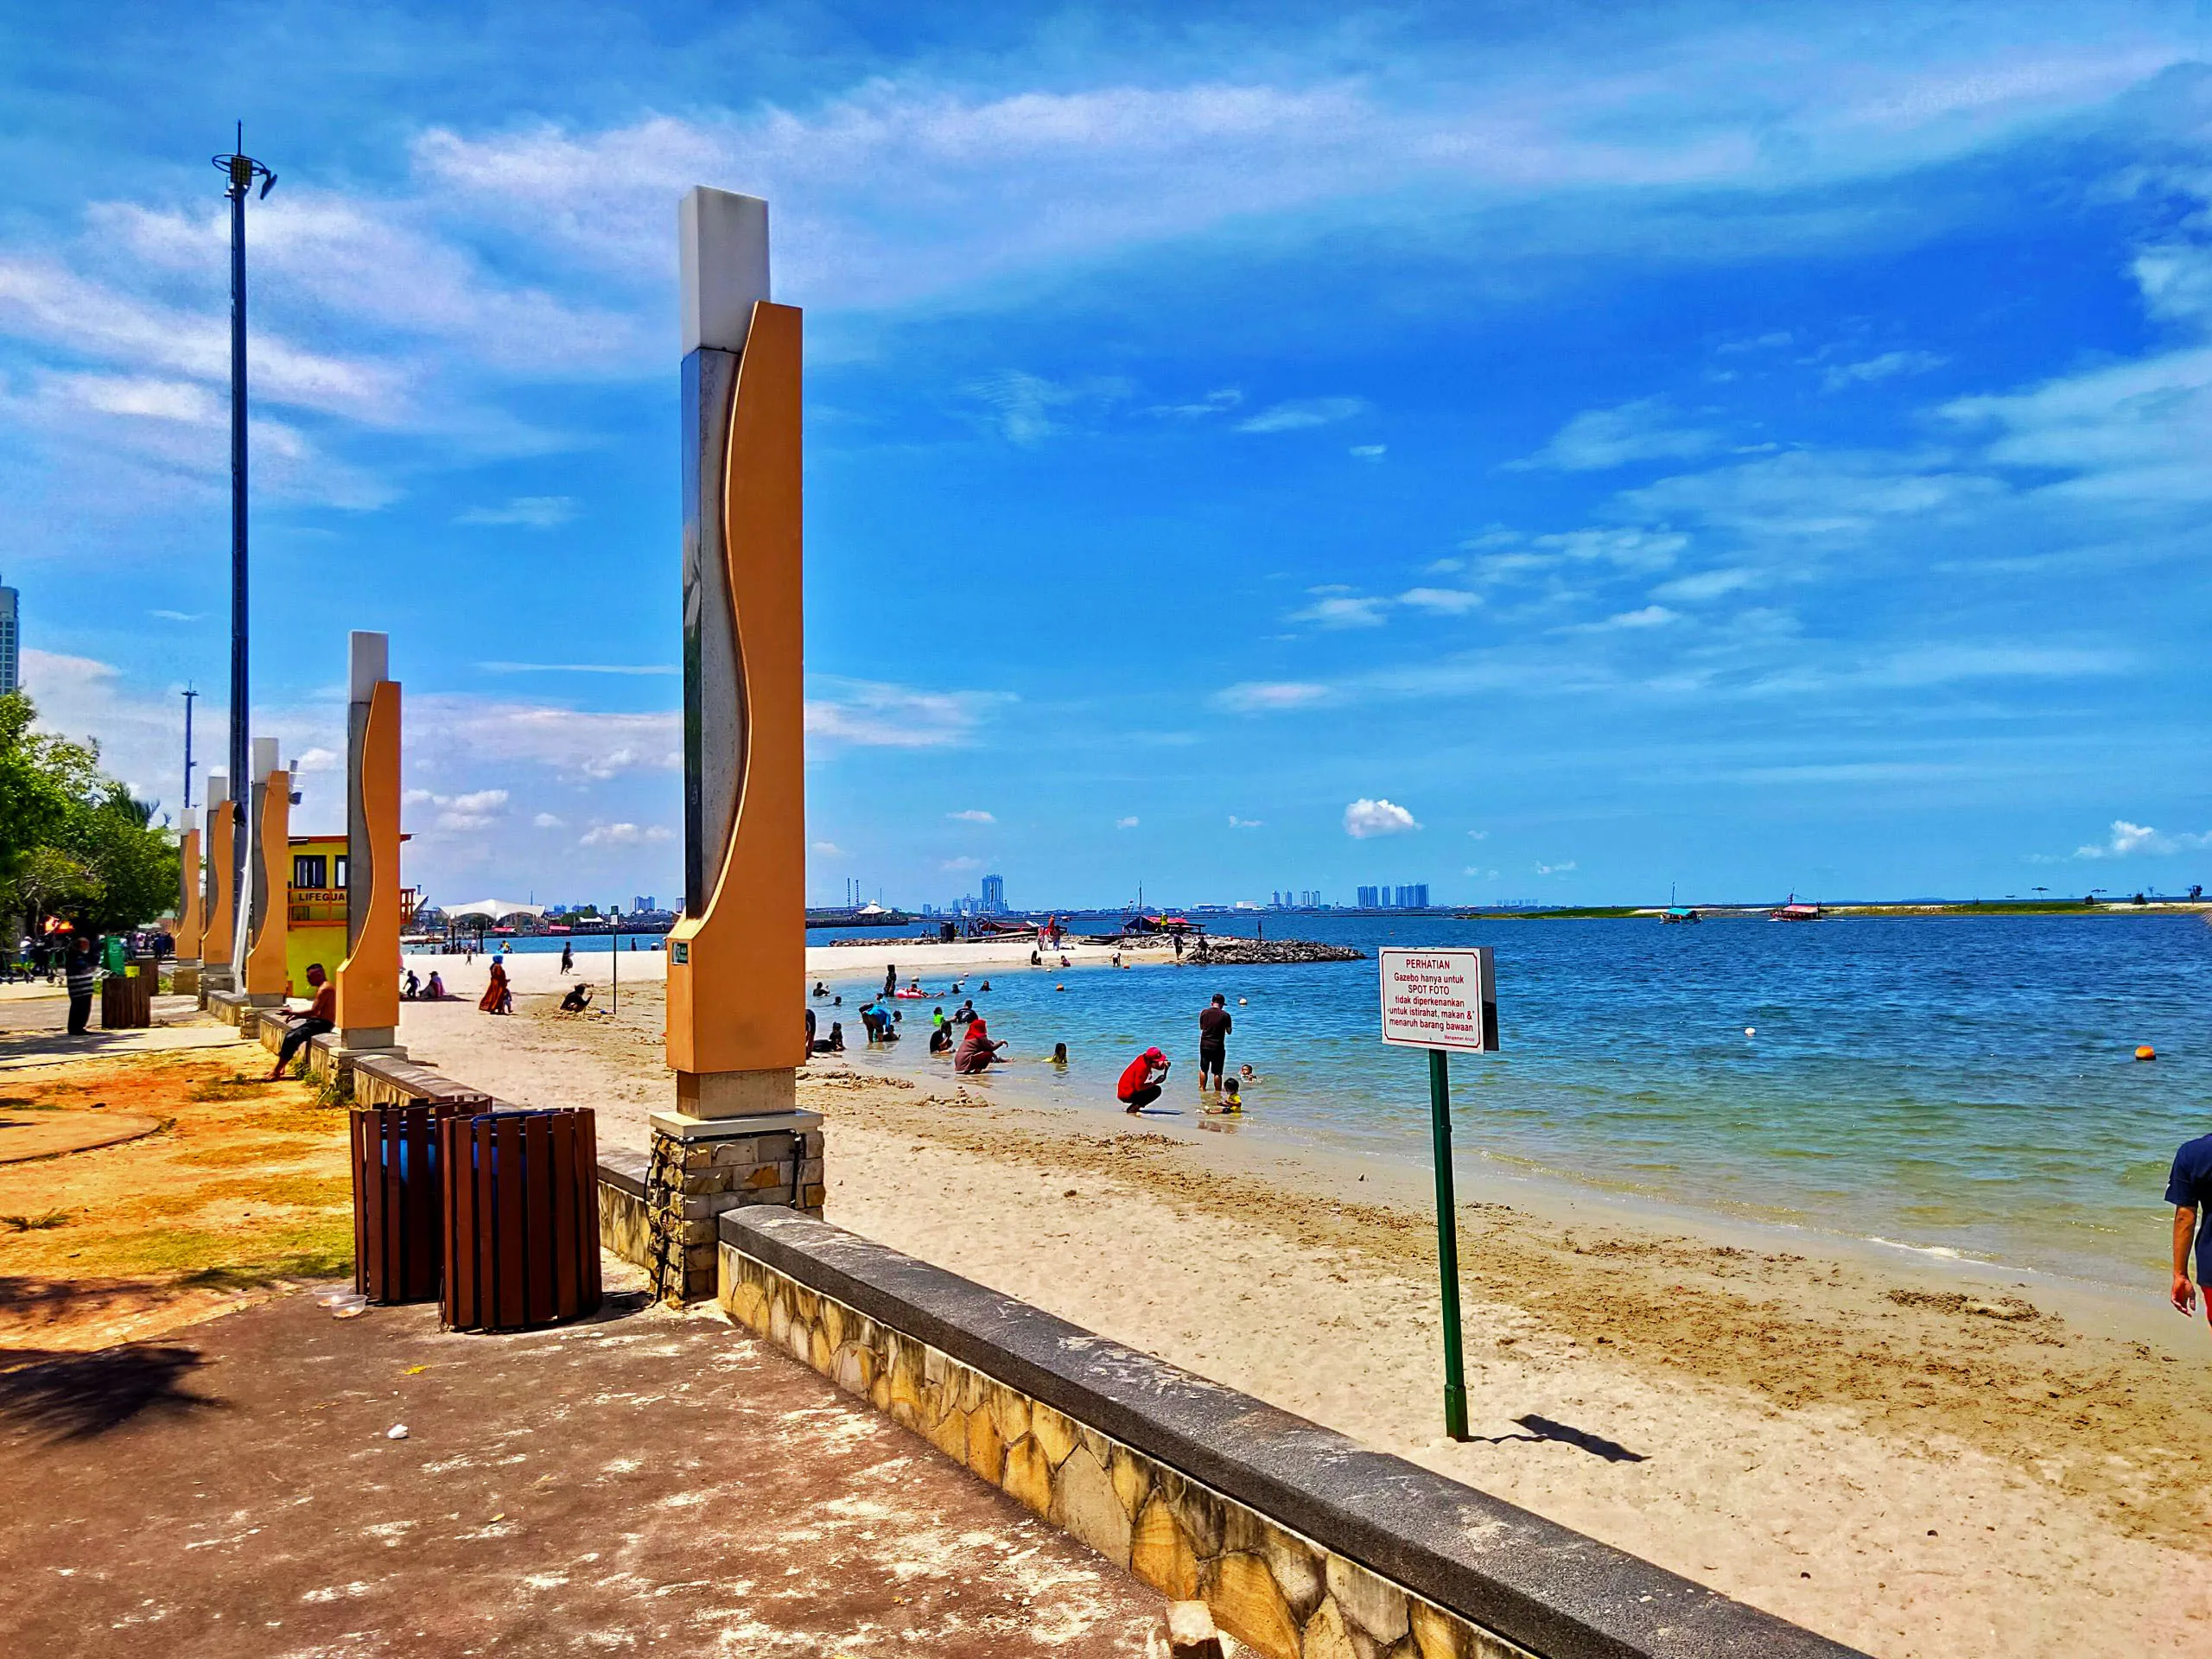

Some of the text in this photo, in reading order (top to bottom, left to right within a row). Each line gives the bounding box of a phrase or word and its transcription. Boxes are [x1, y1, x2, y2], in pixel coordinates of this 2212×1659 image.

[299, 893, 346, 901] LIFEGUA
[1406, 959, 1450, 969] PERHATIAN
[1394, 972, 1465, 984] Gazebo hanya untuk
[1408, 984, 1450, 995] SPOT FOTO
[1395, 995, 1465, 1007] tidak diperkenankan
[1389, 1007, 1472, 1020] untuk istirahat, makan &
[1389, 1018, 1473, 1032] menaruh barang bawaan
